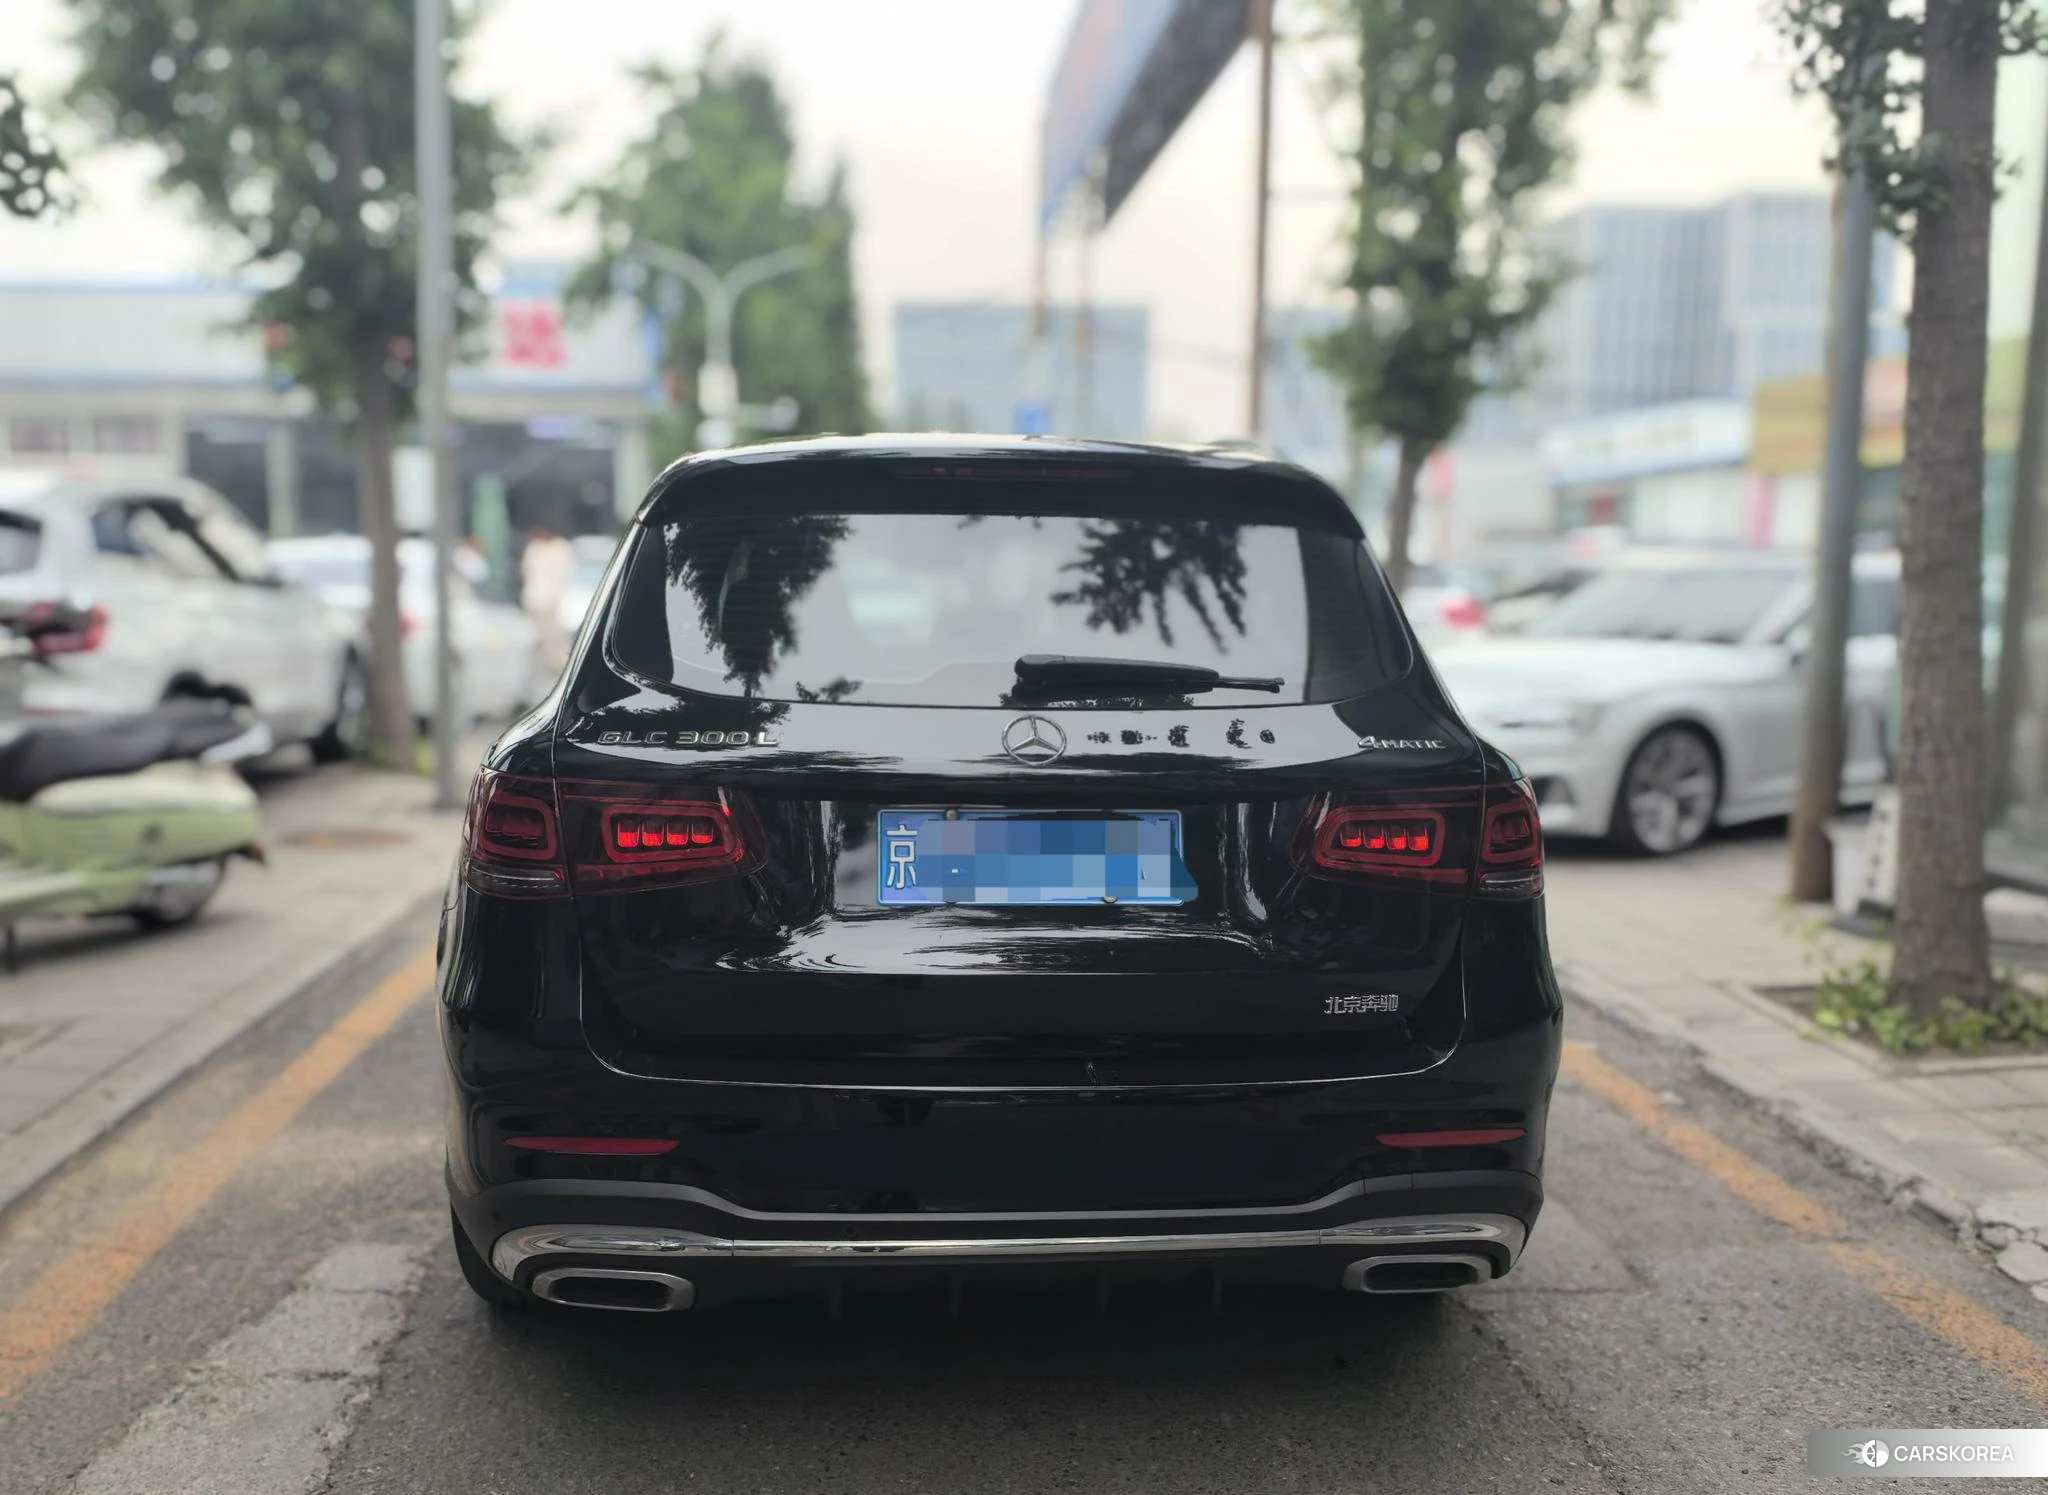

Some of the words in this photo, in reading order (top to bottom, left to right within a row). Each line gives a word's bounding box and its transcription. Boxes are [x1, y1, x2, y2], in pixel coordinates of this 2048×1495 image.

[598, 730, 668, 745] GLC
[1358, 735, 1446, 749] 4MATIC
[886, 824, 918, 889] 京
[1323, 994, 1399, 1014] 北京奔驰
